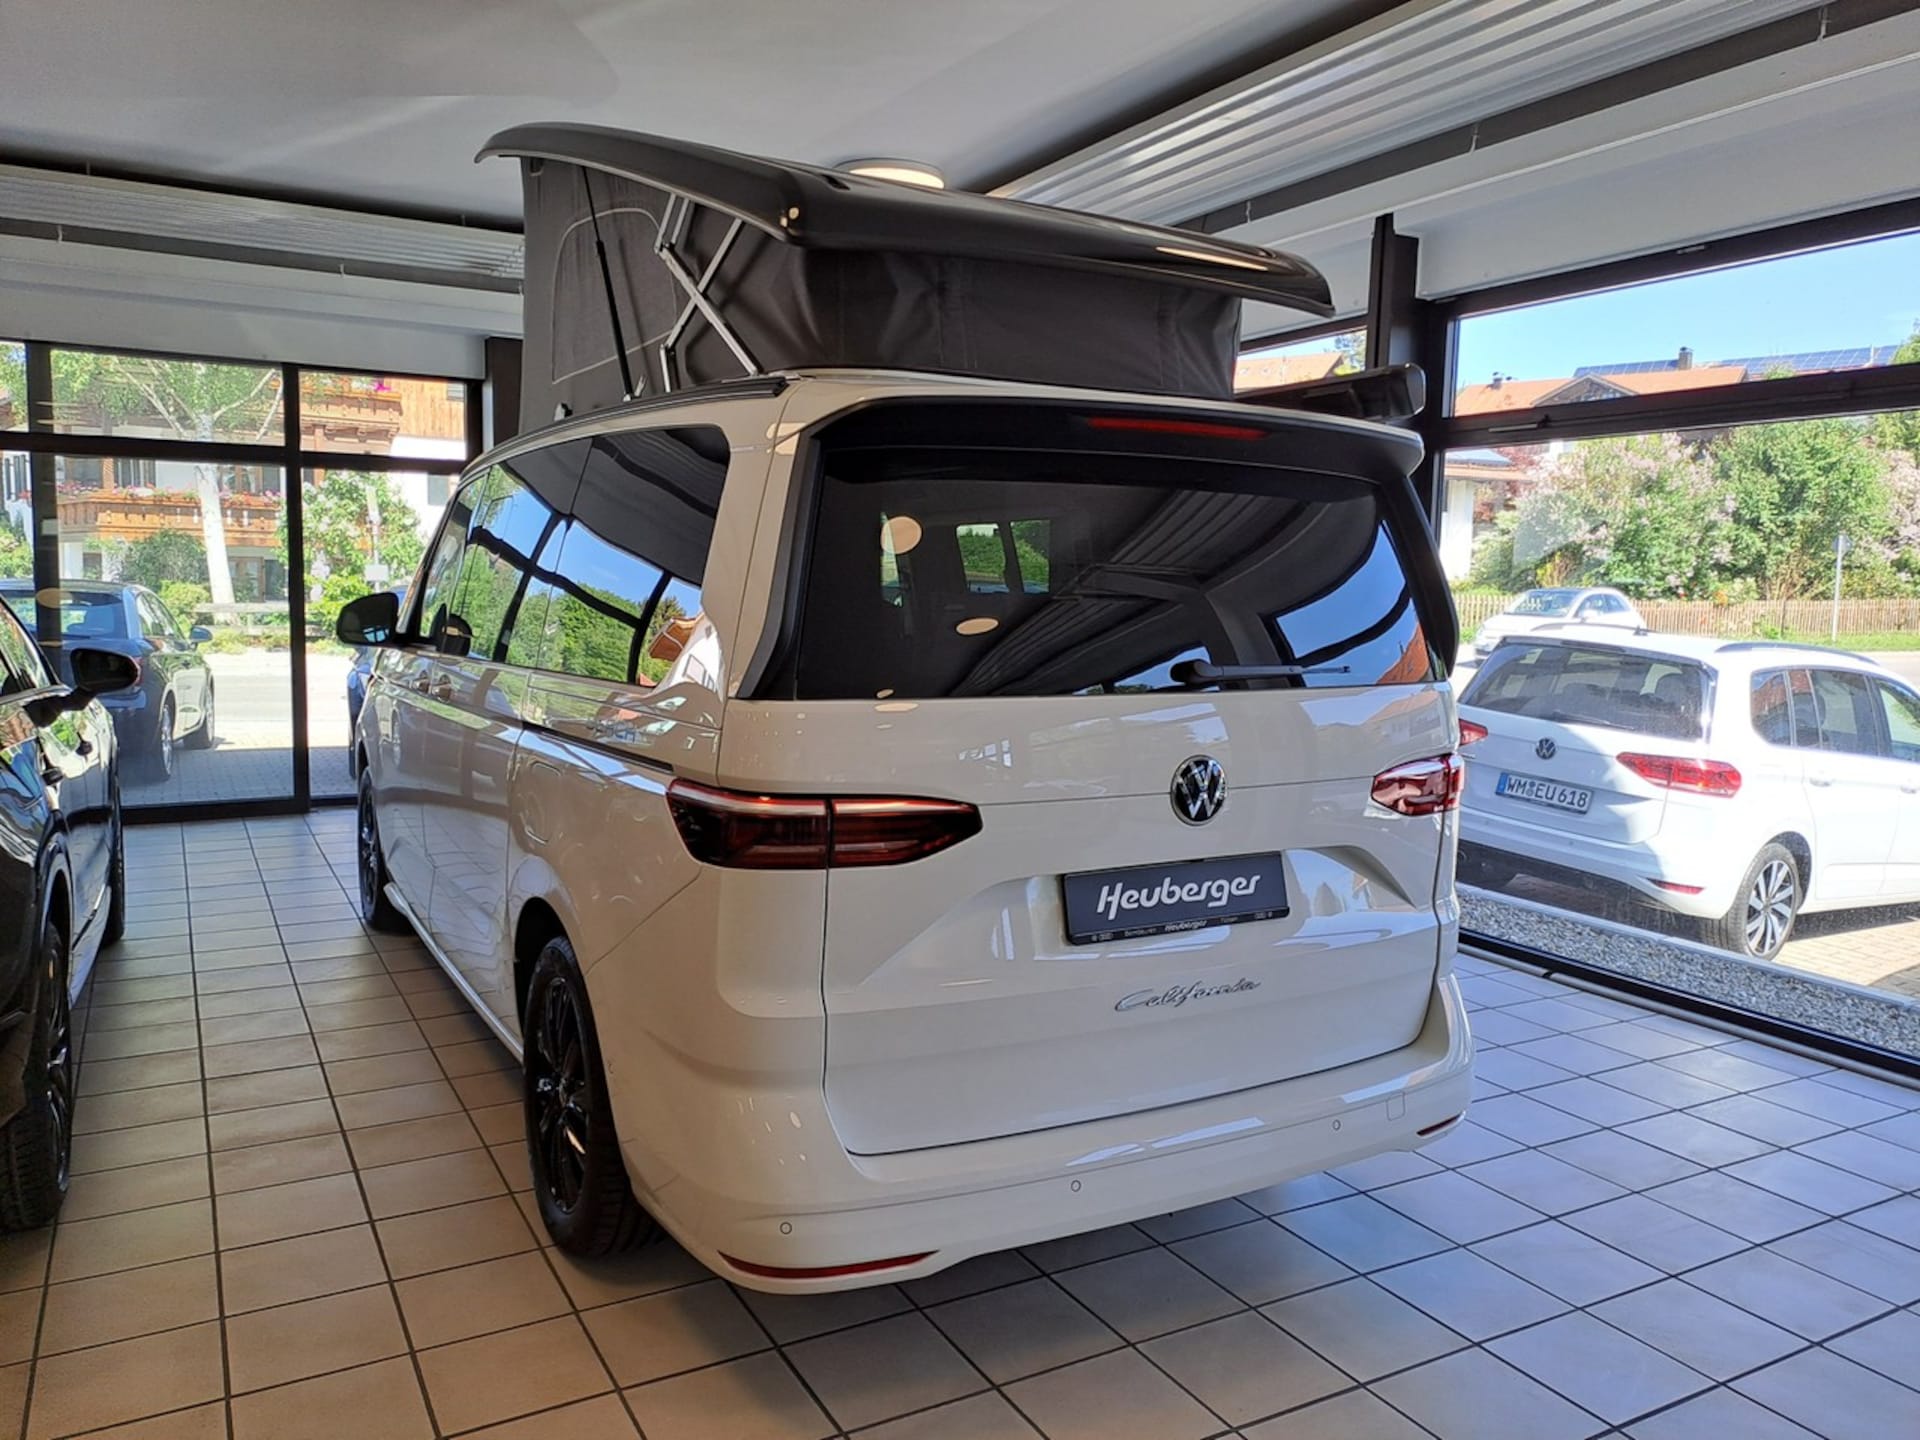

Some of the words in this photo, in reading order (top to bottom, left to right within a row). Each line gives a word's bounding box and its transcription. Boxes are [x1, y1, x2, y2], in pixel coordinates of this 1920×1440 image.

[1507, 777, 1528, 795] WM
[1097, 875, 1260, 920] Heuberger
[1115, 978, 1261, 1011] California
